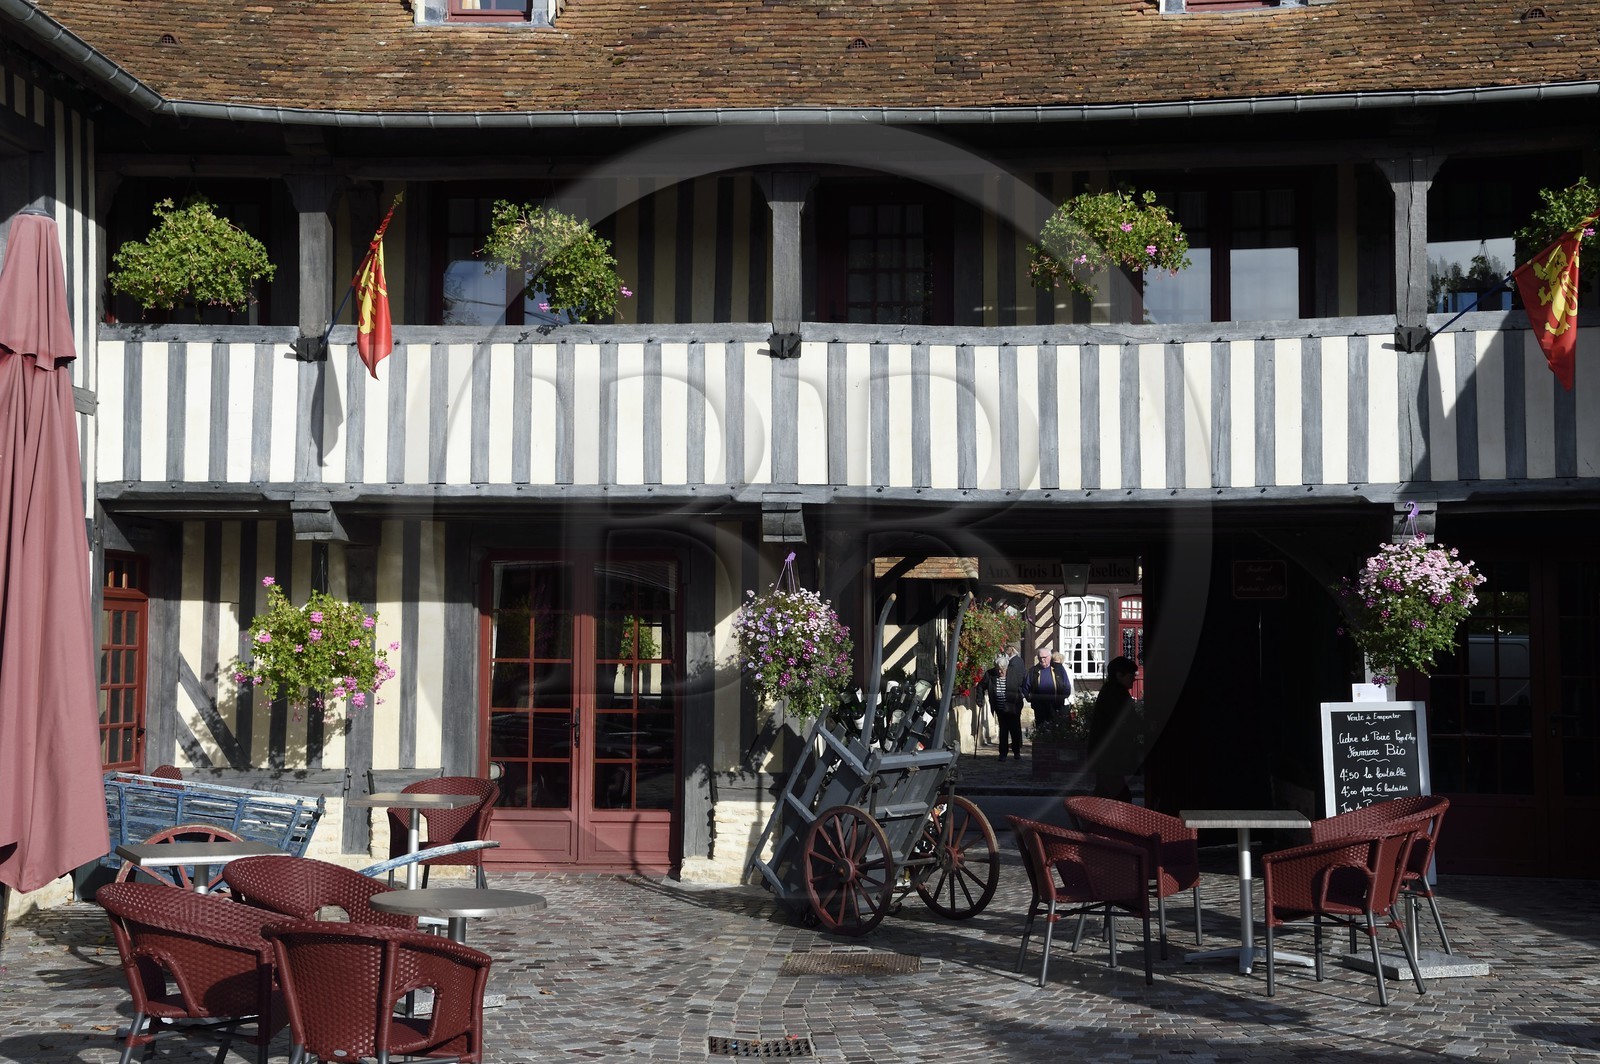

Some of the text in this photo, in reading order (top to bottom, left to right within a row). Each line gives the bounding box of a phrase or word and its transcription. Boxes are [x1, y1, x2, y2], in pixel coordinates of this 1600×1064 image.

[987, 563, 1131, 578] Aux Trois Diselles
[1346, 712, 1365, 721] Vente
[1373, 712, 1402, 722] Emporter
[1338, 732, 1359, 744] Cidre
[1361, 734, 1370, 742] et
[1370, 730, 1391, 741] Poiré
[1346, 743, 1406, 758] Fermiers Bio
[1363, 766, 1373, 779] la
[1375, 766, 1407, 779] bouteille
[1376, 782, 1383, 792] 6
